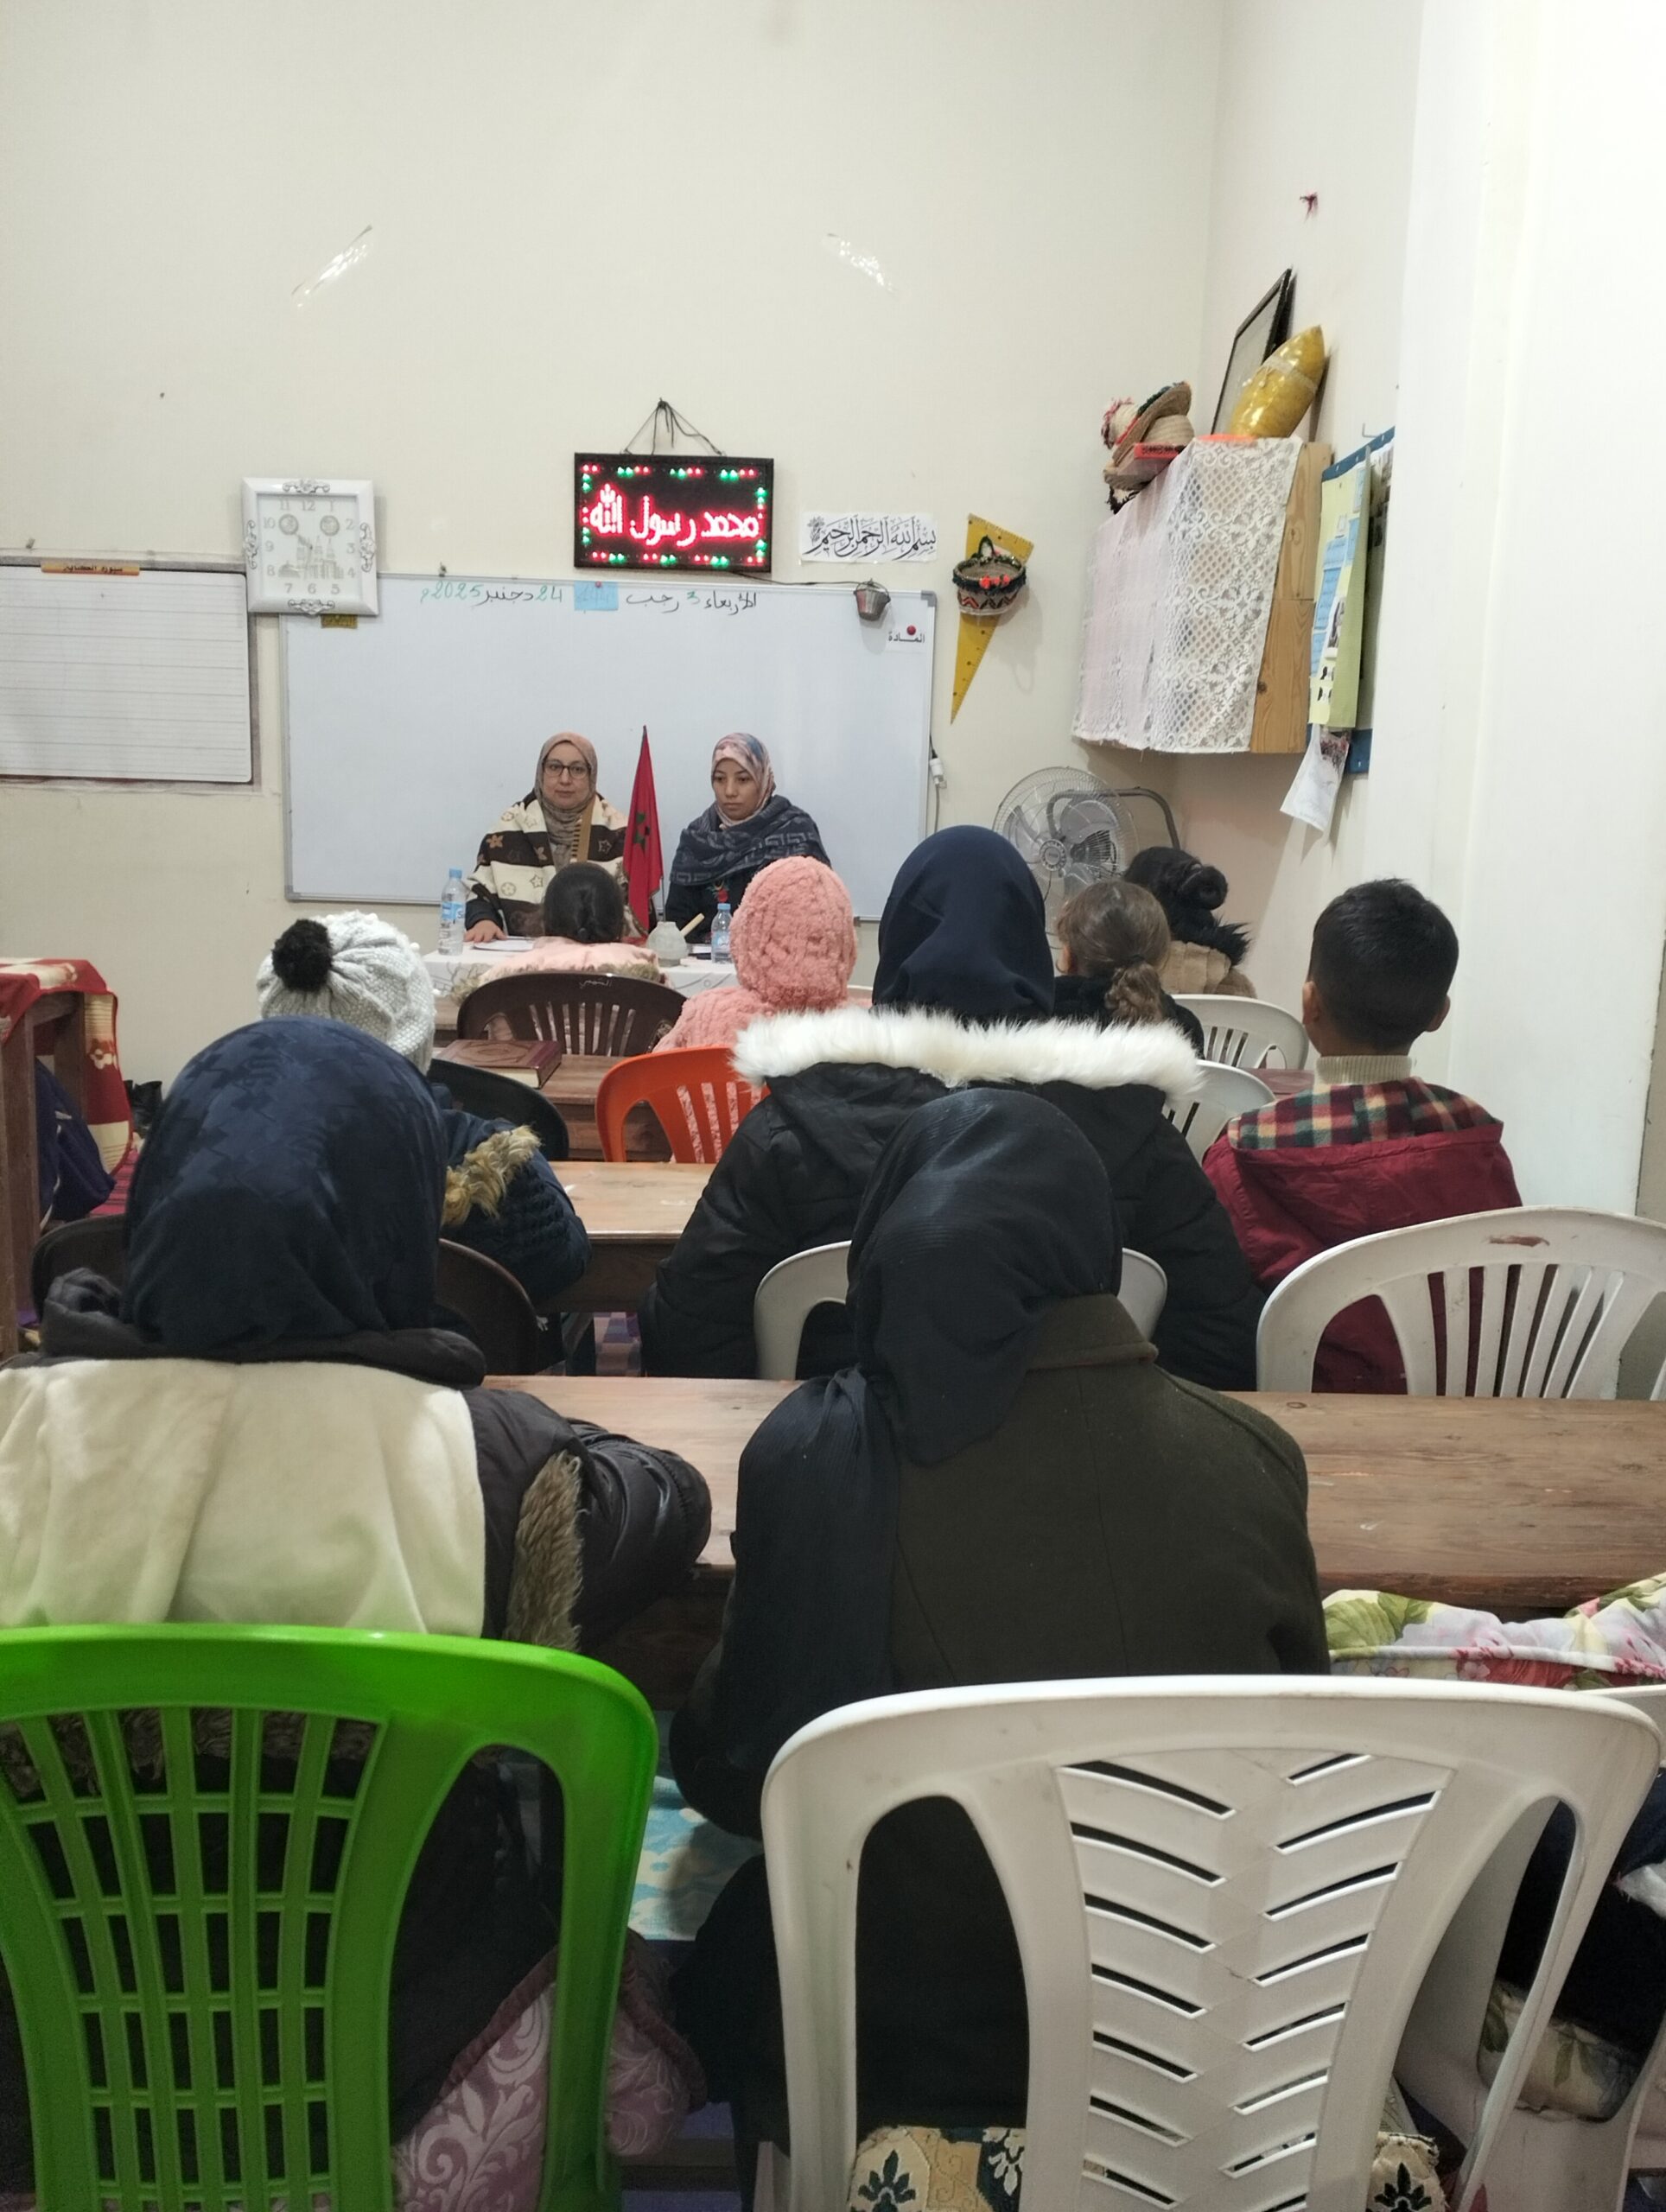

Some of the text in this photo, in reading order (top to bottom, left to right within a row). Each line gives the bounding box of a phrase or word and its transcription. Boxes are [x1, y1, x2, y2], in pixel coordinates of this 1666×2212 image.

[279, 499, 290, 511] 11
[302, 499, 315, 512] 12
[328, 499, 334, 512] 1
[590, 484, 760, 547] محمد رسول الله
[263, 517, 276, 529] 10
[345, 518, 354, 530] 2
[264, 540, 274, 552] 9
[347, 543, 355, 554] 3
[267, 564, 276, 576] 8
[347, 567, 356, 578] 4
[284, 583, 293, 594] 7
[308, 582, 316, 594] 6
[331, 584, 340, 594] 5
[535, 584, 563, 603] 24
[471, 586, 534, 607] دجنبر
[687, 591, 700, 605] 3
[626, 594, 679, 613] رجب
[887, 631, 925, 643] المادة
